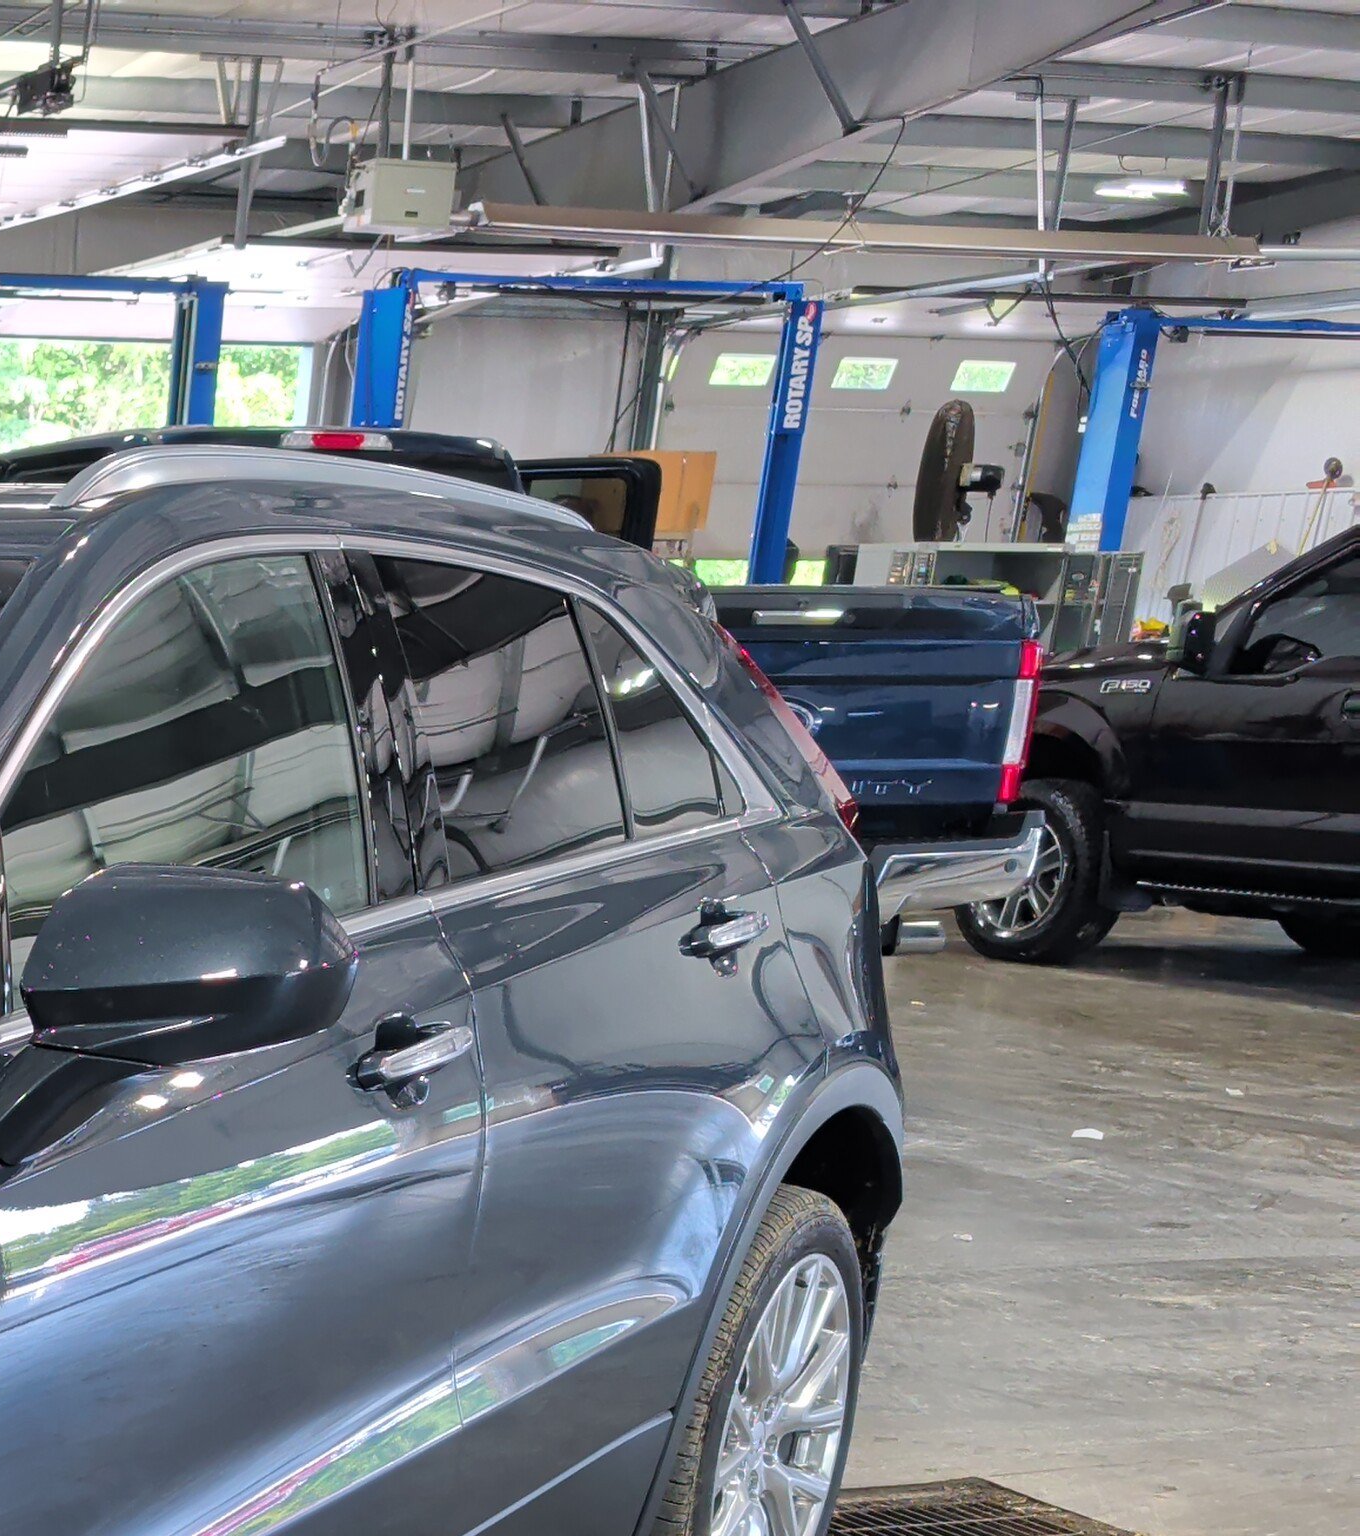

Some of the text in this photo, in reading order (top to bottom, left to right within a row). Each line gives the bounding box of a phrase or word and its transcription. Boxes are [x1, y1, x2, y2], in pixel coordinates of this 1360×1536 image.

[394, 336, 410, 421] ROTARY
[782, 315, 814, 429] ROTARY SP
